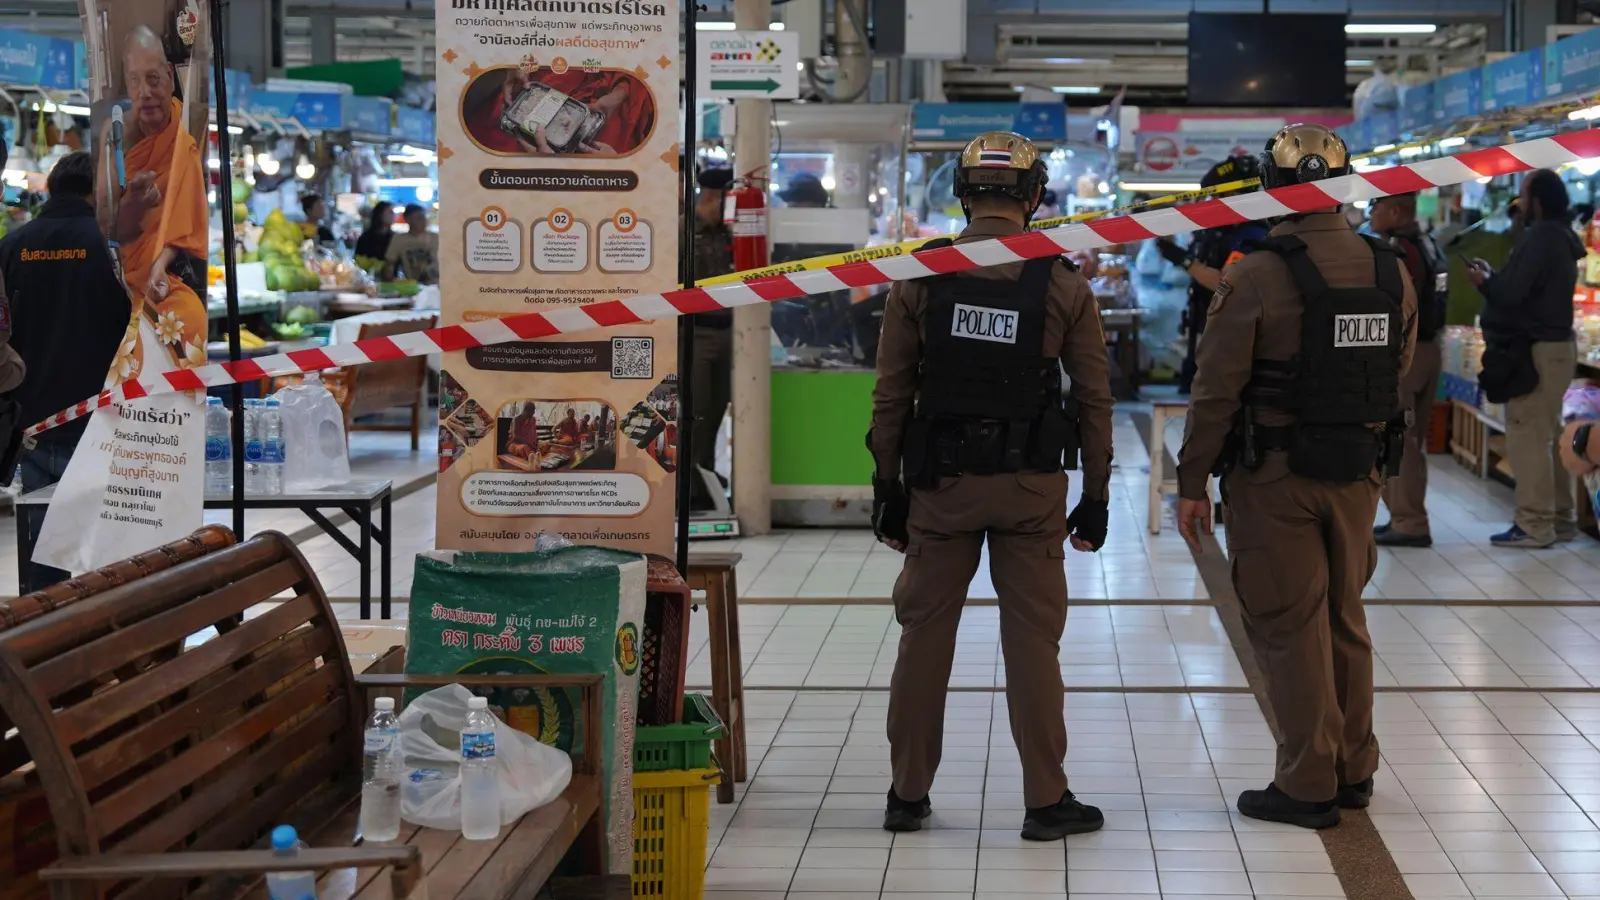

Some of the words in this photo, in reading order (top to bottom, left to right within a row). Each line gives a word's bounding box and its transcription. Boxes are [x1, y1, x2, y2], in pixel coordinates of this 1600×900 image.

[452, 0, 666, 16] มหากุศลตกบาตรไร้โรค
[455, 16, 577, 30] ถวายภัตตาหารเพื่อสุขภาพ
[581, 19, 662, 33] แด่พระภิกษุอาพาธ
[490, 170, 628, 187] ขั้นตอนการถวายภัตตาหาร
[487, 214, 498, 223] 01
[554, 215, 566, 224] 02
[619, 216, 631, 225] 03
[20, 247, 87, 262] สืบสวนนครบาล
[524, 296, 545, 304] ติดต่อ
[956, 308, 1014, 339] POLICE
[1338, 316, 1386, 343] POLICE
[459, 529, 520, 543] สนับสนุนโดย
[431, 602, 497, 626] ข้าวเหนียวหอม
[505, 614, 531, 631] พันธุ์
[589, 618, 597, 627] 2
[441, 629, 469, 648] ตรา
[528, 634, 544, 654] 3
[550, 636, 586, 654] เพชร
